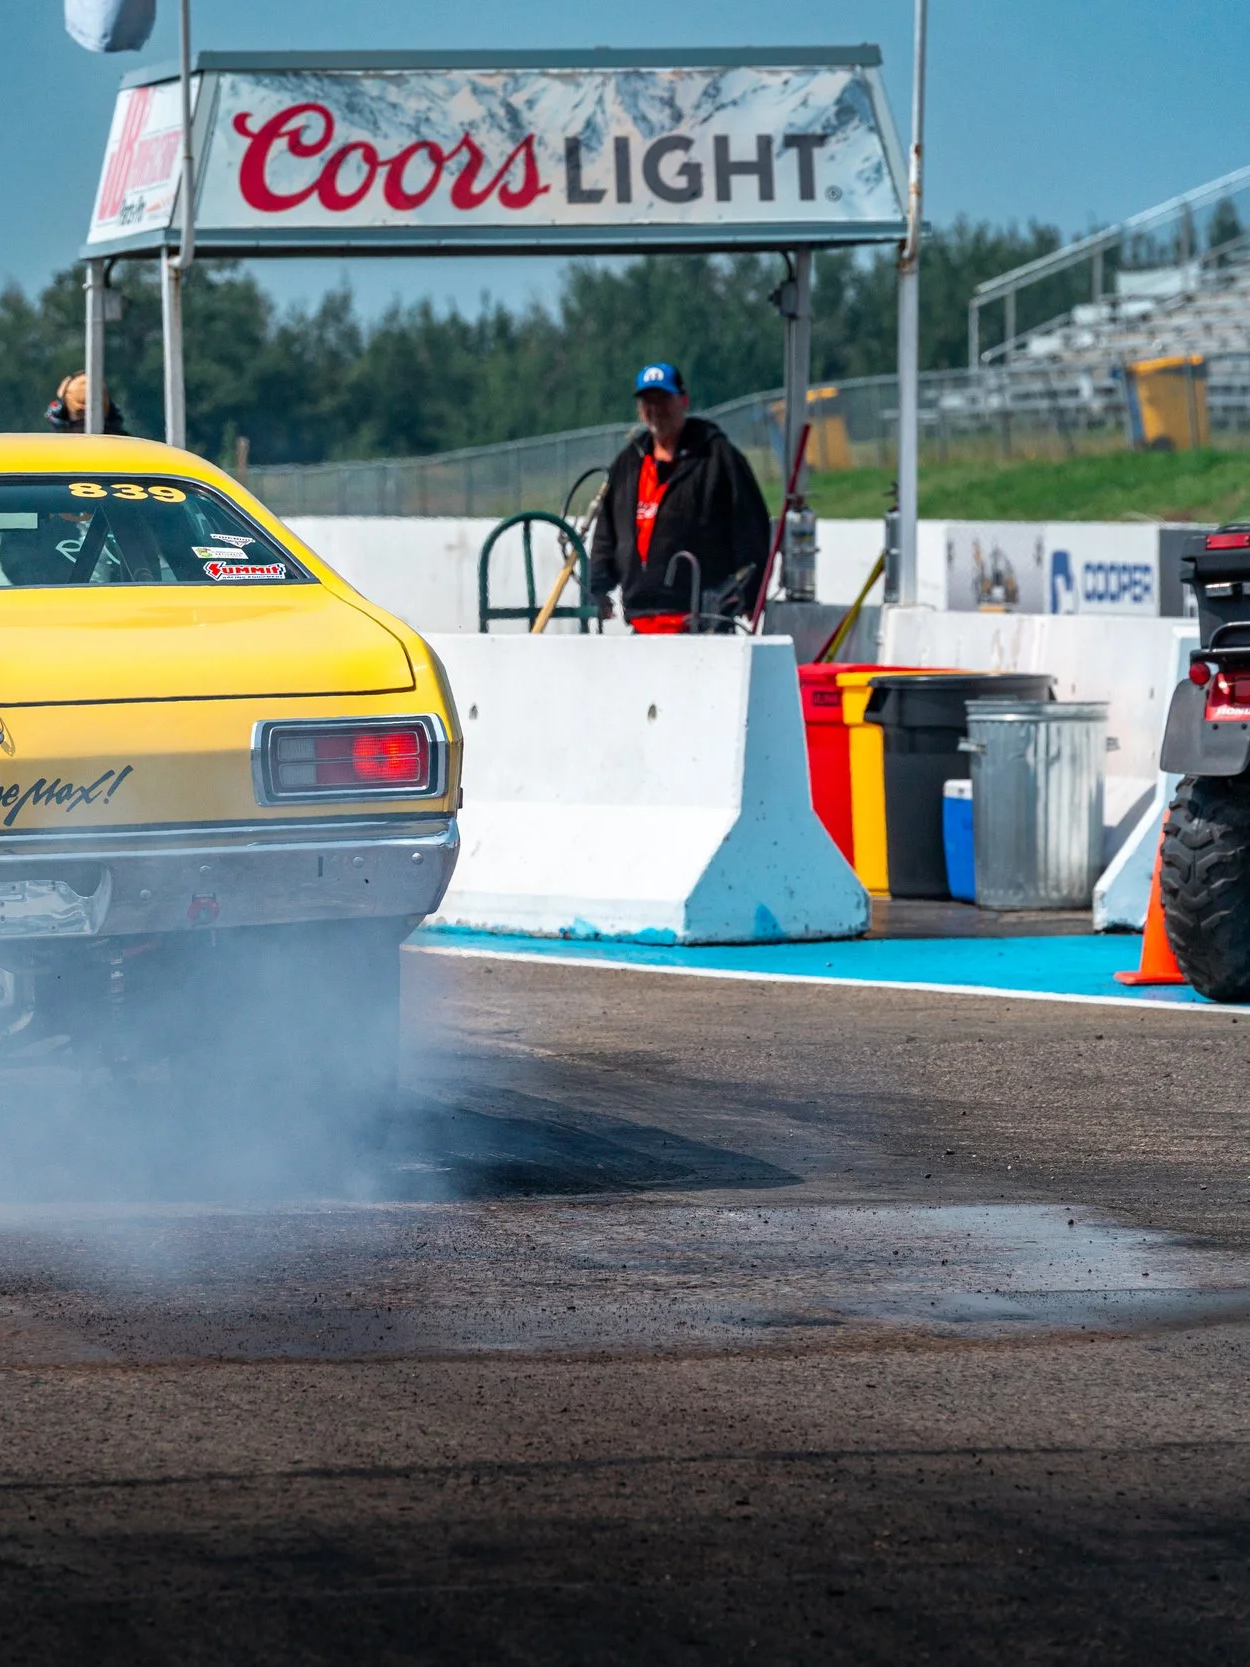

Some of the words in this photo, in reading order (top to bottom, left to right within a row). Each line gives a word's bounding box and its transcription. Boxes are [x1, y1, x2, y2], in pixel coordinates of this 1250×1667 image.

[233, 103, 550, 213] Coors
[565, 133, 829, 206] LIGHT
[68, 482, 187, 504] 839
[1084, 562, 1151, 603] COOPER
[3, 765, 134, 827] Max!
